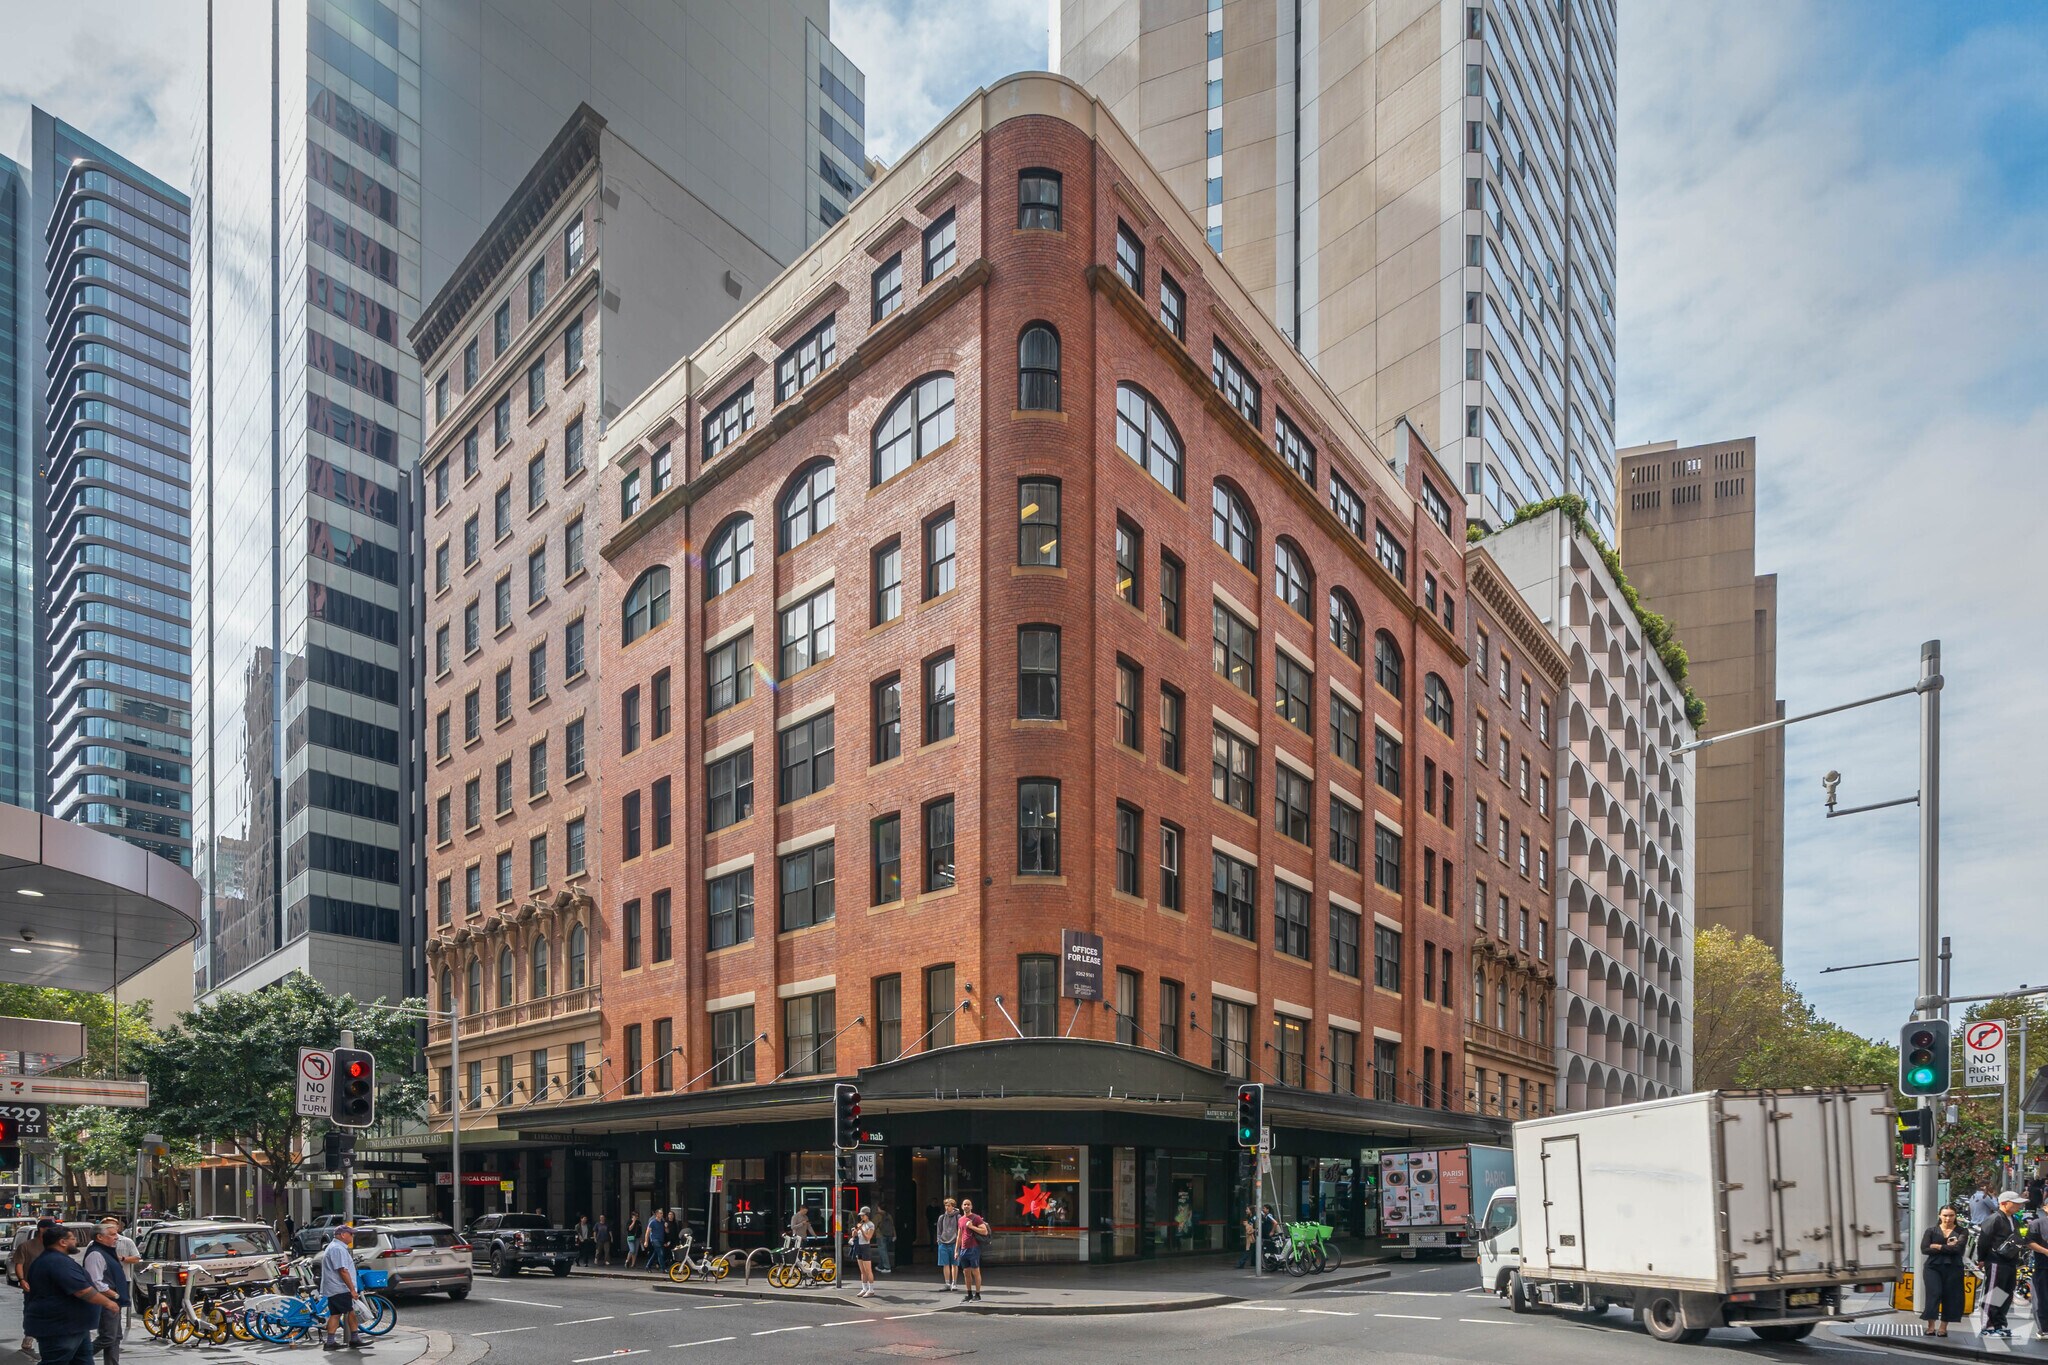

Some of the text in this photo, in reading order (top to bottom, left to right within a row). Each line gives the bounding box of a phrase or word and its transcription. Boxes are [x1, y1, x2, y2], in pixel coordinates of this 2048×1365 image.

[1072, 945, 1098, 956] OFFICES
[1067, 953, 1101, 966] FOR LEASE
[1973, 1053, 1996, 1064] NO
[1968, 1065, 2002, 1074] RIGHT
[1969, 1075, 2000, 1083] TURN
[306, 1082, 325, 1093] NO
[303, 1094, 327, 1103] LEFT
[302, 1104, 327, 1113] TURN
[26, 1124, 41, 1133] ST
[381, 1138, 405, 1147] MECHANICS
[405, 1136, 423, 1145] SCHOOL
[430, 1134, 442, 1143] ARTS
[870, 1132, 884, 1141] nab
[672, 1142, 686, 1150] nab
[1485, 1170, 1507, 1187] PARISI
